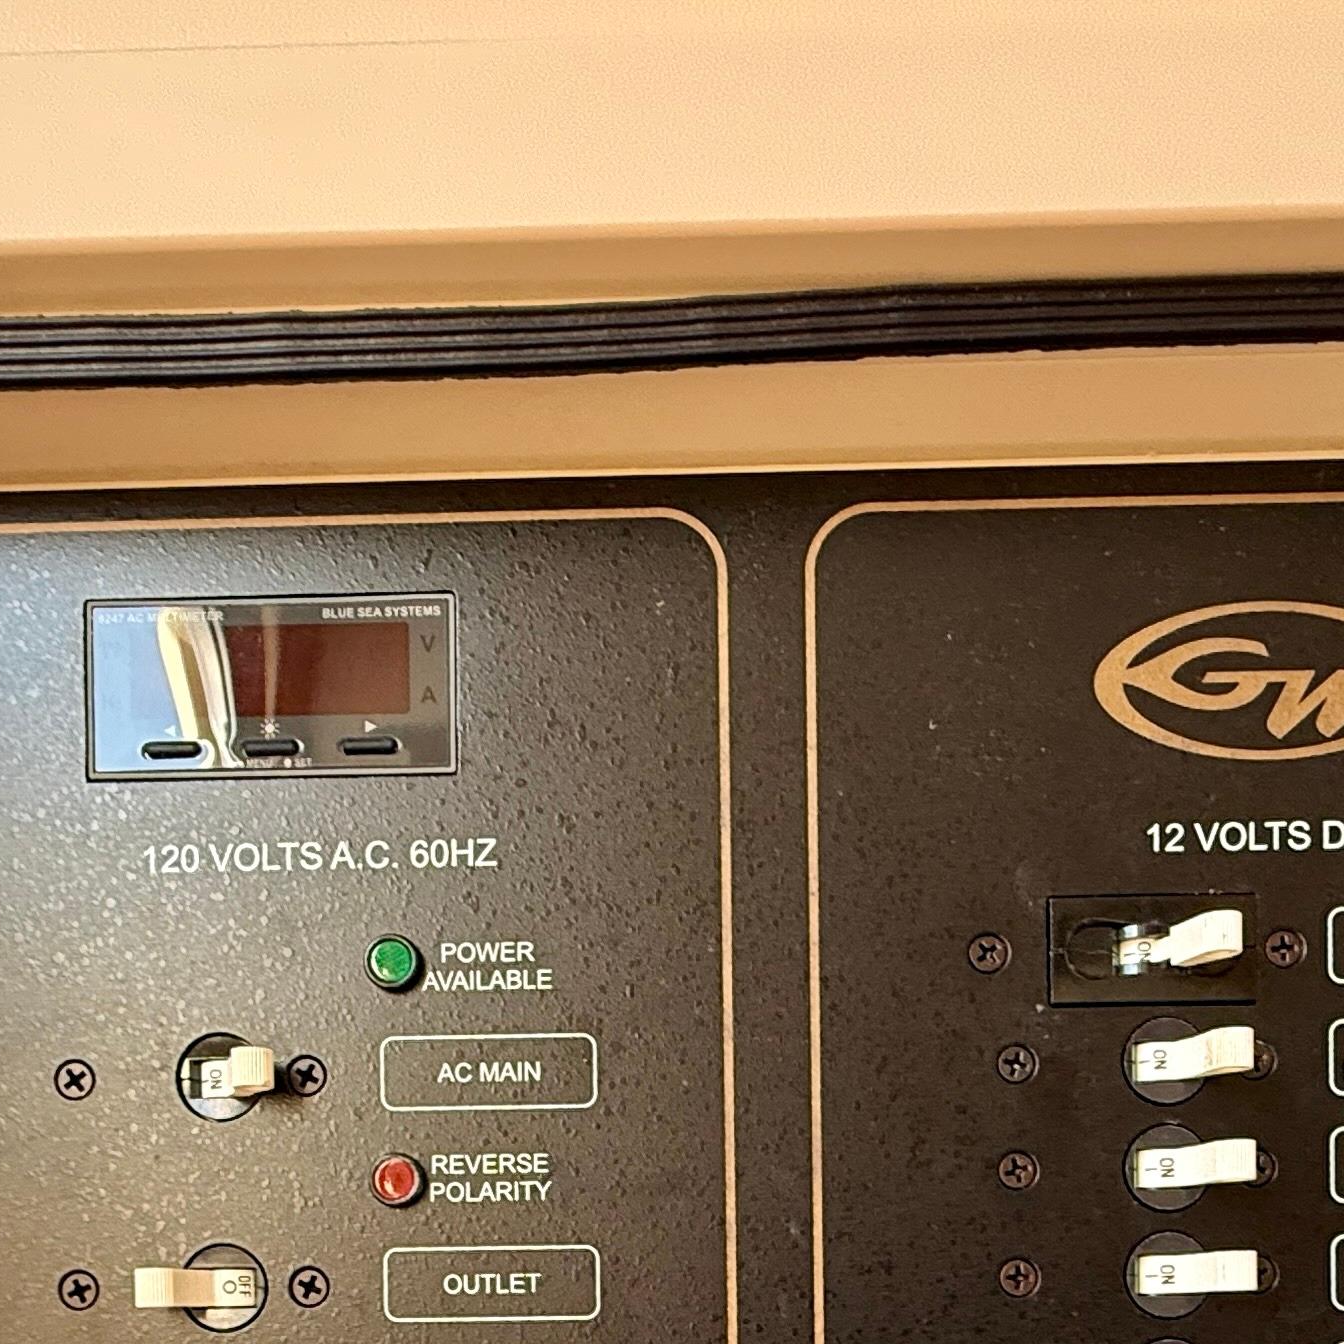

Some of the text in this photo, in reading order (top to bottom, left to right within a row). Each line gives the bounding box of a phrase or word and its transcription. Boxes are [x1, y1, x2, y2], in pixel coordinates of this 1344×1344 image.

[321, 604, 442, 620] BLUE SEA SYSTEMS
[420, 634, 436, 653] V
[420, 685, 437, 703] A
[294, 757, 313, 768] SET
[1146, 822, 1185, 853] 12
[1193, 820, 1312, 852] VOLTS
[142, 837, 498, 876] 120 VOLTS A.C. 60HZ
[440, 940, 536, 964] POWER
[420, 968, 554, 993] AVAILABLE
[1153, 1049, 1167, 1070] ON
[210, 1069, 223, 1090] ON
[436, 1060, 542, 1084] AC MAIN
[430, 1152, 550, 1175] REVERSE
[1159, 1157, 1174, 1178] ON
[429, 1180, 553, 1203] POLARITY
[442, 1272, 543, 1295] OUTLET
[1160, 1264, 1175, 1285] ON
[238, 1275, 252, 1298] OFF
